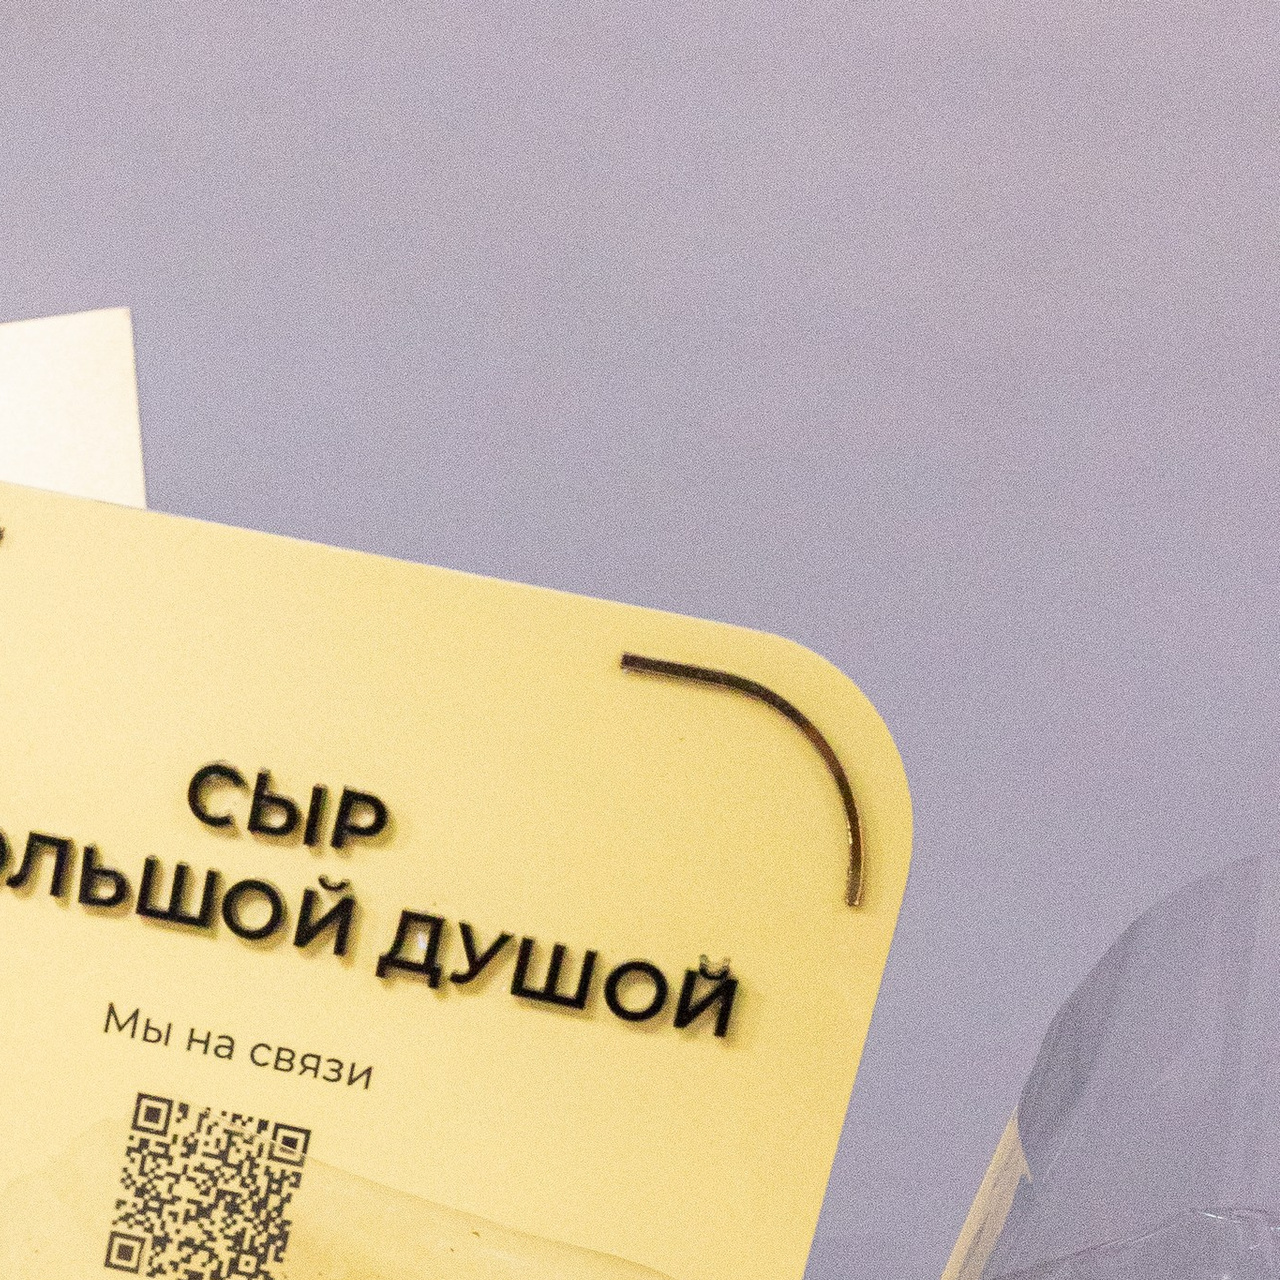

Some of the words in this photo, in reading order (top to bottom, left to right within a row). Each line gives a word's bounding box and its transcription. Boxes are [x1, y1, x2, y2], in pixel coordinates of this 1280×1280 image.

[186, 762, 390, 851] СЫР
[374, 909, 740, 1040] ДУШОЙ
[102, 1001, 173, 1047] Мы
[185, 1027, 236, 1061] на
[248, 1041, 374, 1091] связи
